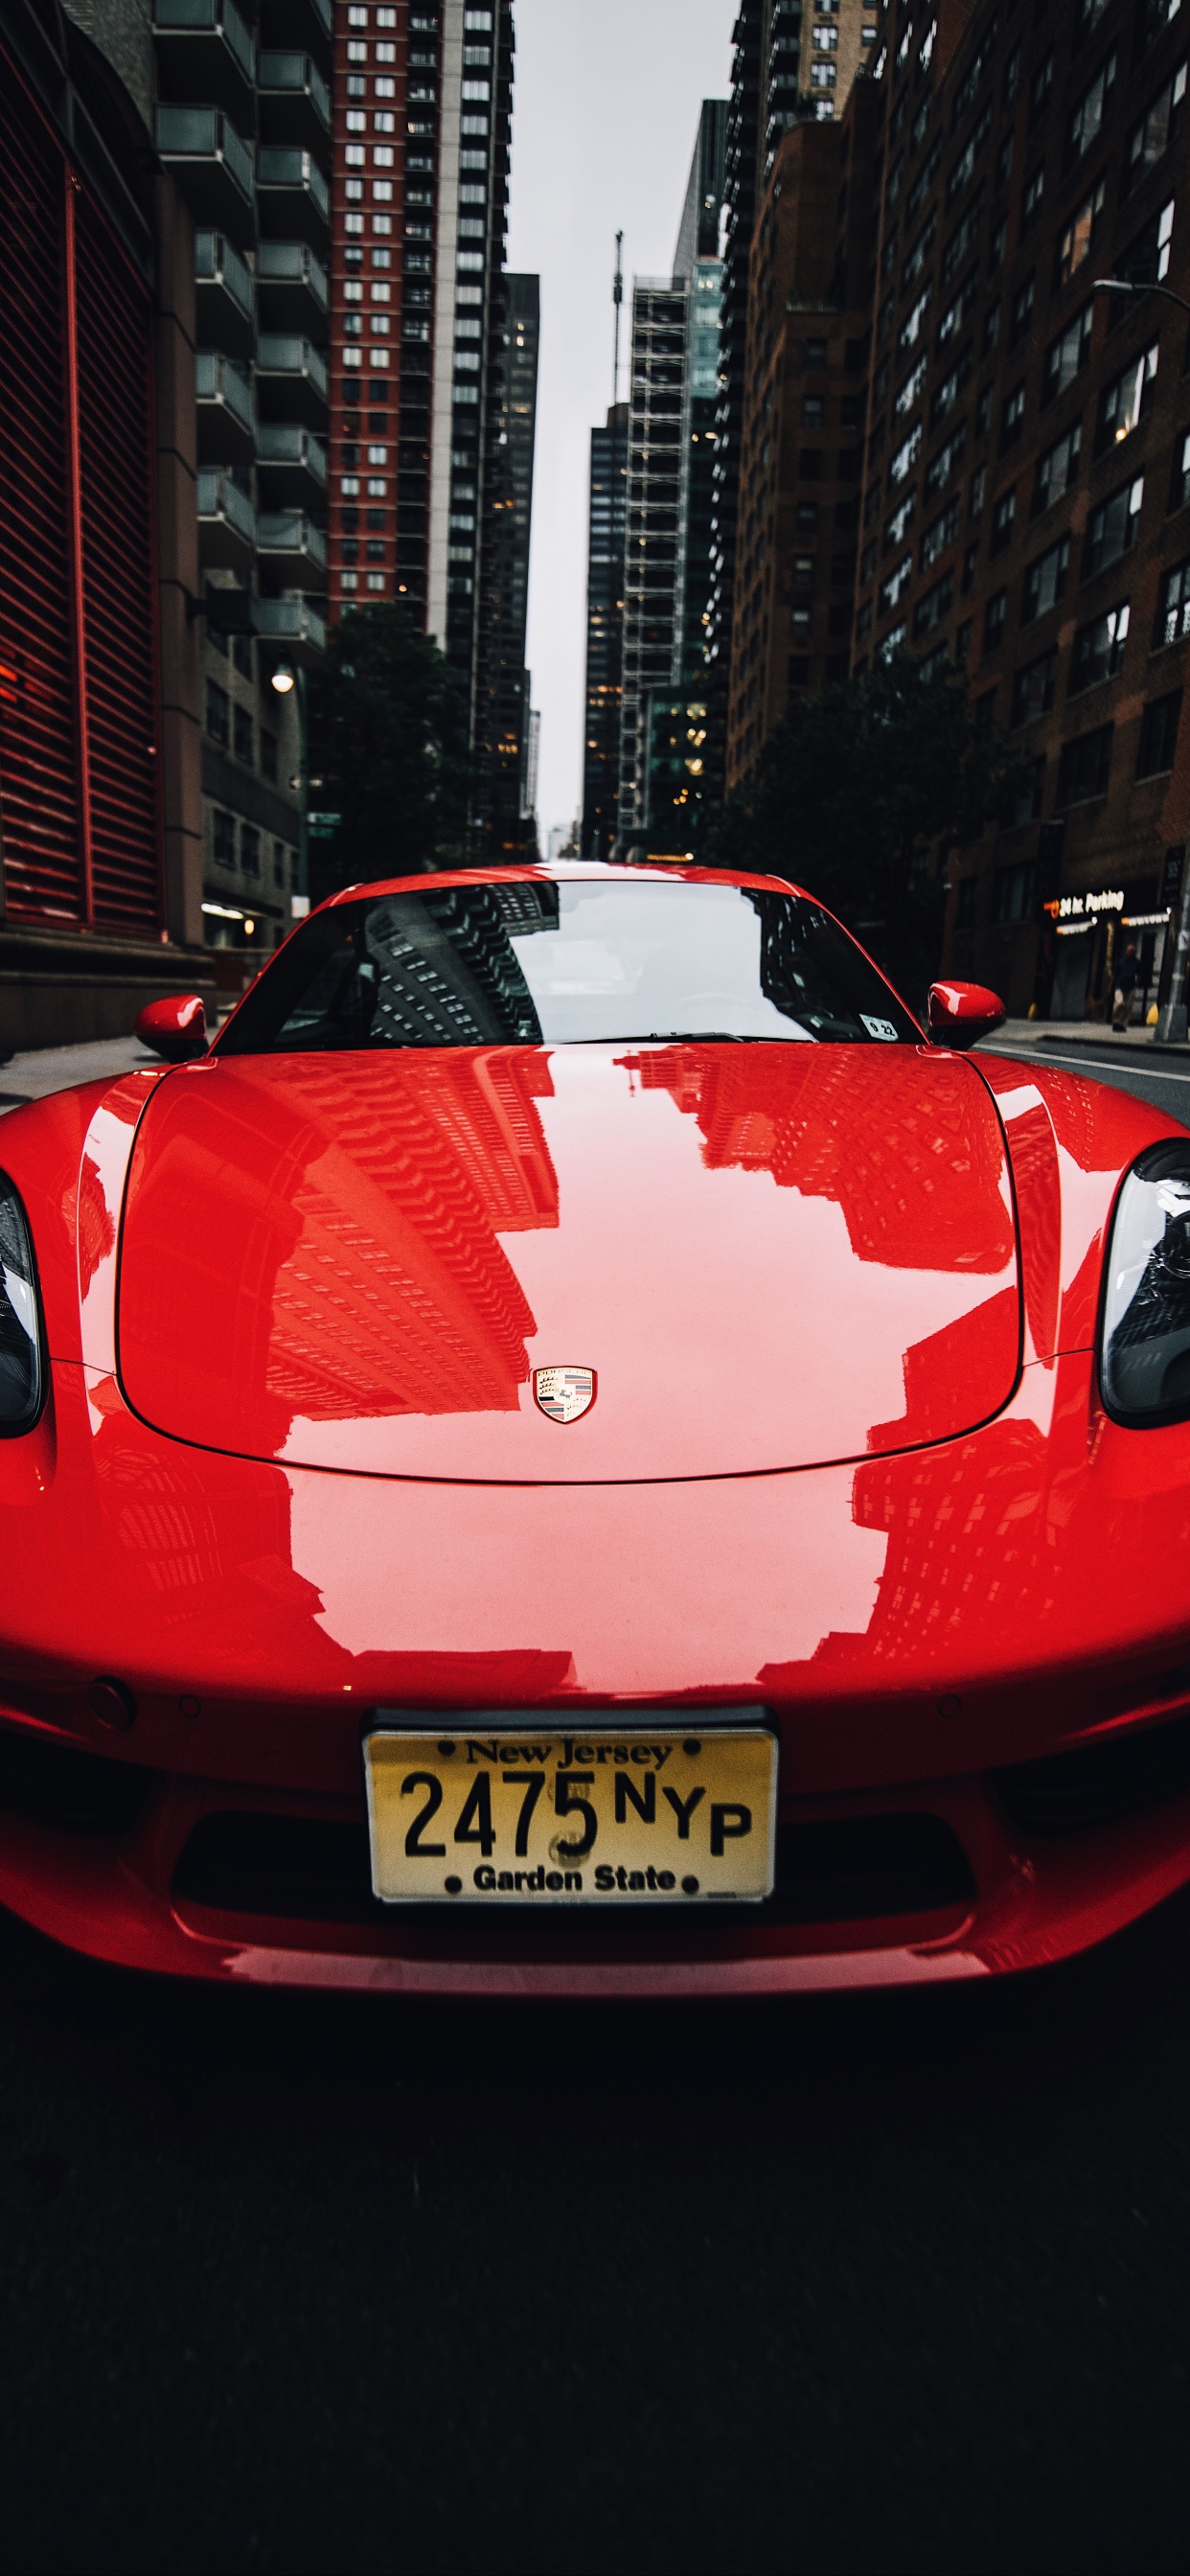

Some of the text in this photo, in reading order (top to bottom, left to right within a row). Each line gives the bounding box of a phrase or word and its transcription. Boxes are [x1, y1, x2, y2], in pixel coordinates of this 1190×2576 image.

[1059, 897, 1072, 917] 24
[1086, 889, 1125, 913] Parking
[870, 1022, 896, 1037] 9 22
[465, 1738, 675, 1770] New Jersey
[400, 1771, 753, 1857] 2475 NYP
[473, 1864, 676, 1892] Garden State
